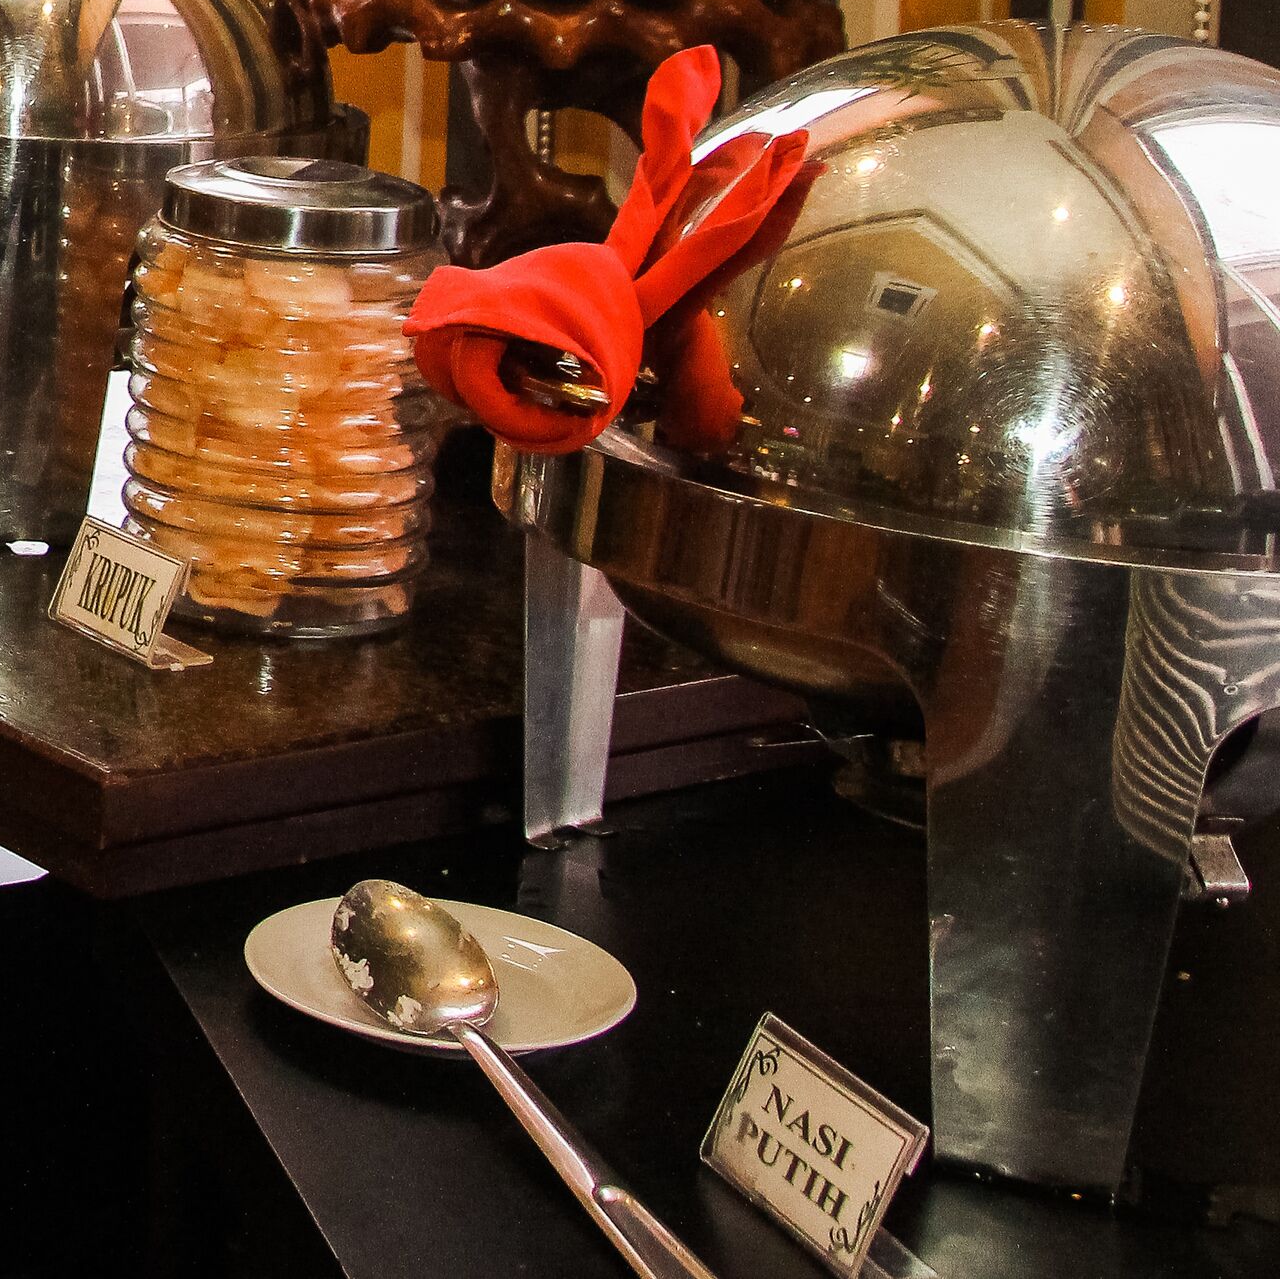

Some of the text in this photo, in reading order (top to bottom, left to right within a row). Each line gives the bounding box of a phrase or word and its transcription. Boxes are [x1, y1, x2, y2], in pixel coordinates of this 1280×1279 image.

[77, 552, 157, 635] KRUPUK
[736, 1112, 850, 1223] PUTIH
[760, 1083, 854, 1170] NASI
